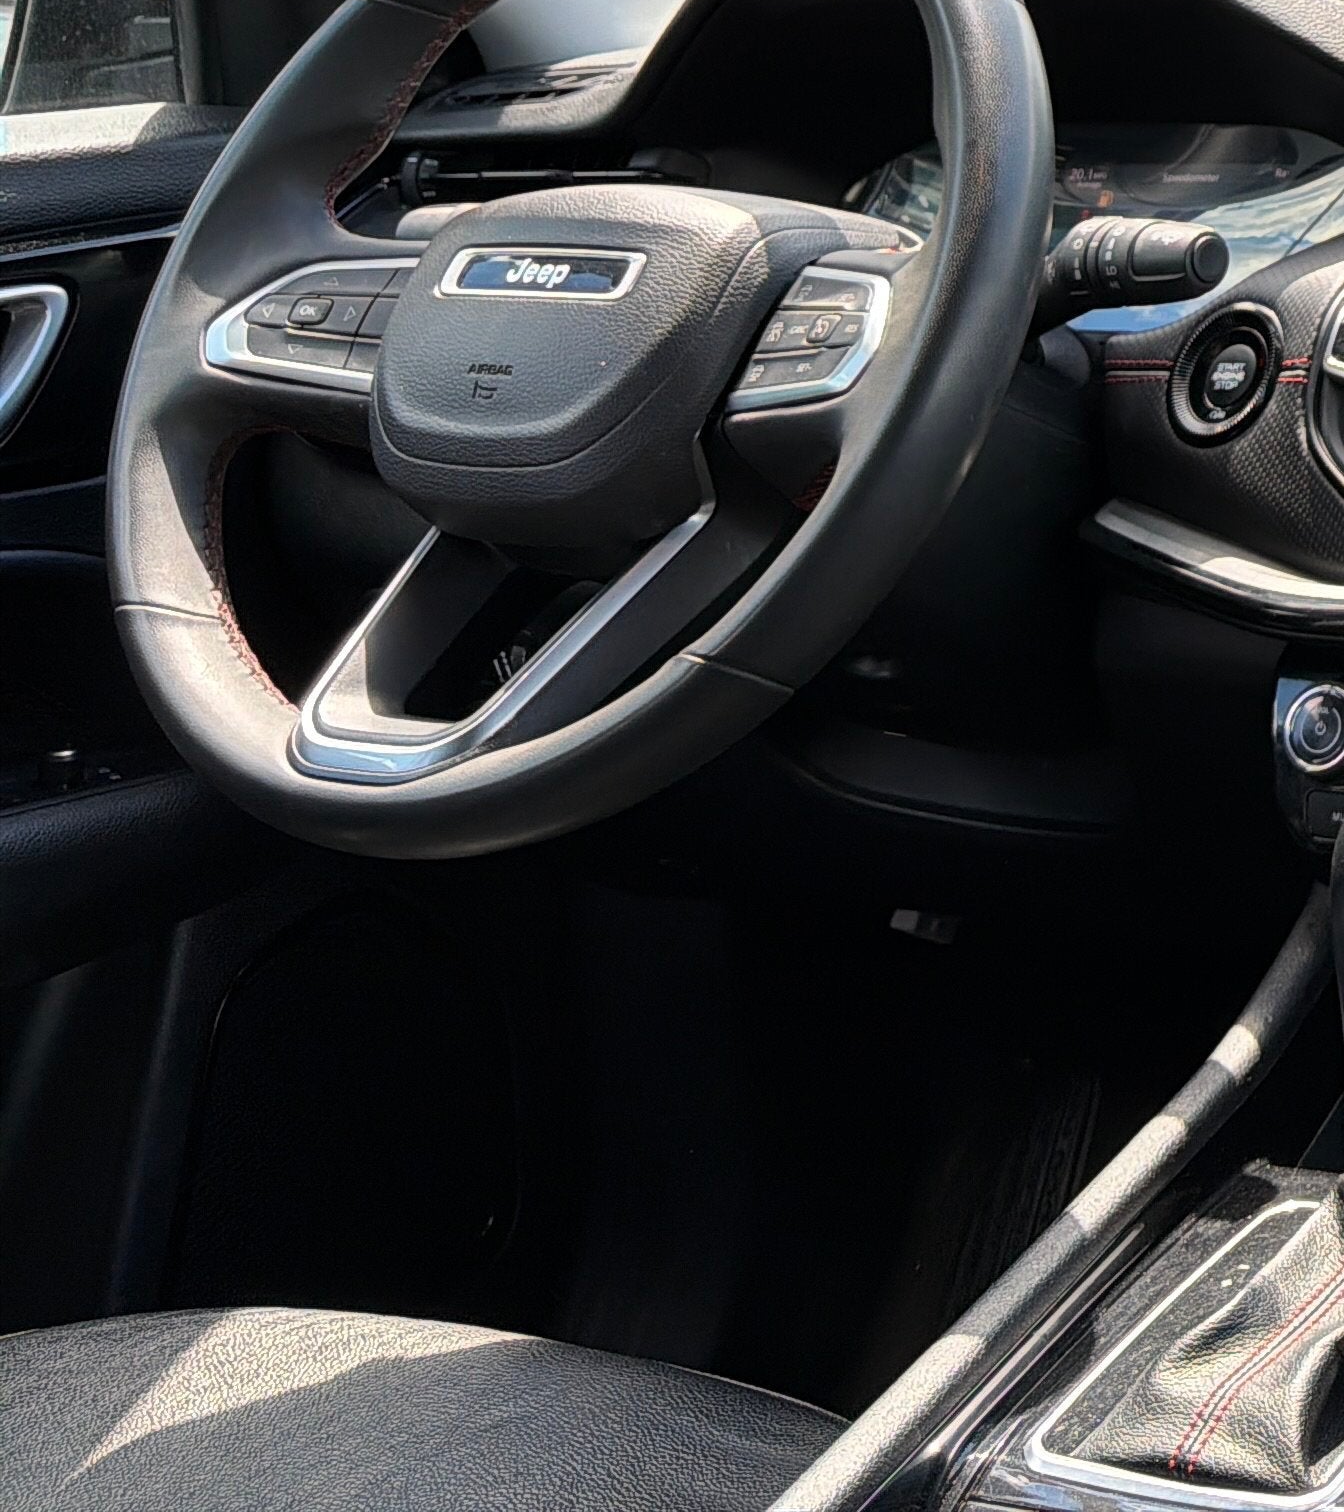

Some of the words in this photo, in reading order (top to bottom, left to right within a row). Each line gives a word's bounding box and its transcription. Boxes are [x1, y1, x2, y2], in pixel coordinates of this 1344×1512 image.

[506, 258, 571, 288] Jeep
[299, 305, 316, 316] OK
[467, 364, 514, 376] AIRBAG
[1216, 362, 1246, 372] START
[1214, 380, 1239, 390] STOP
